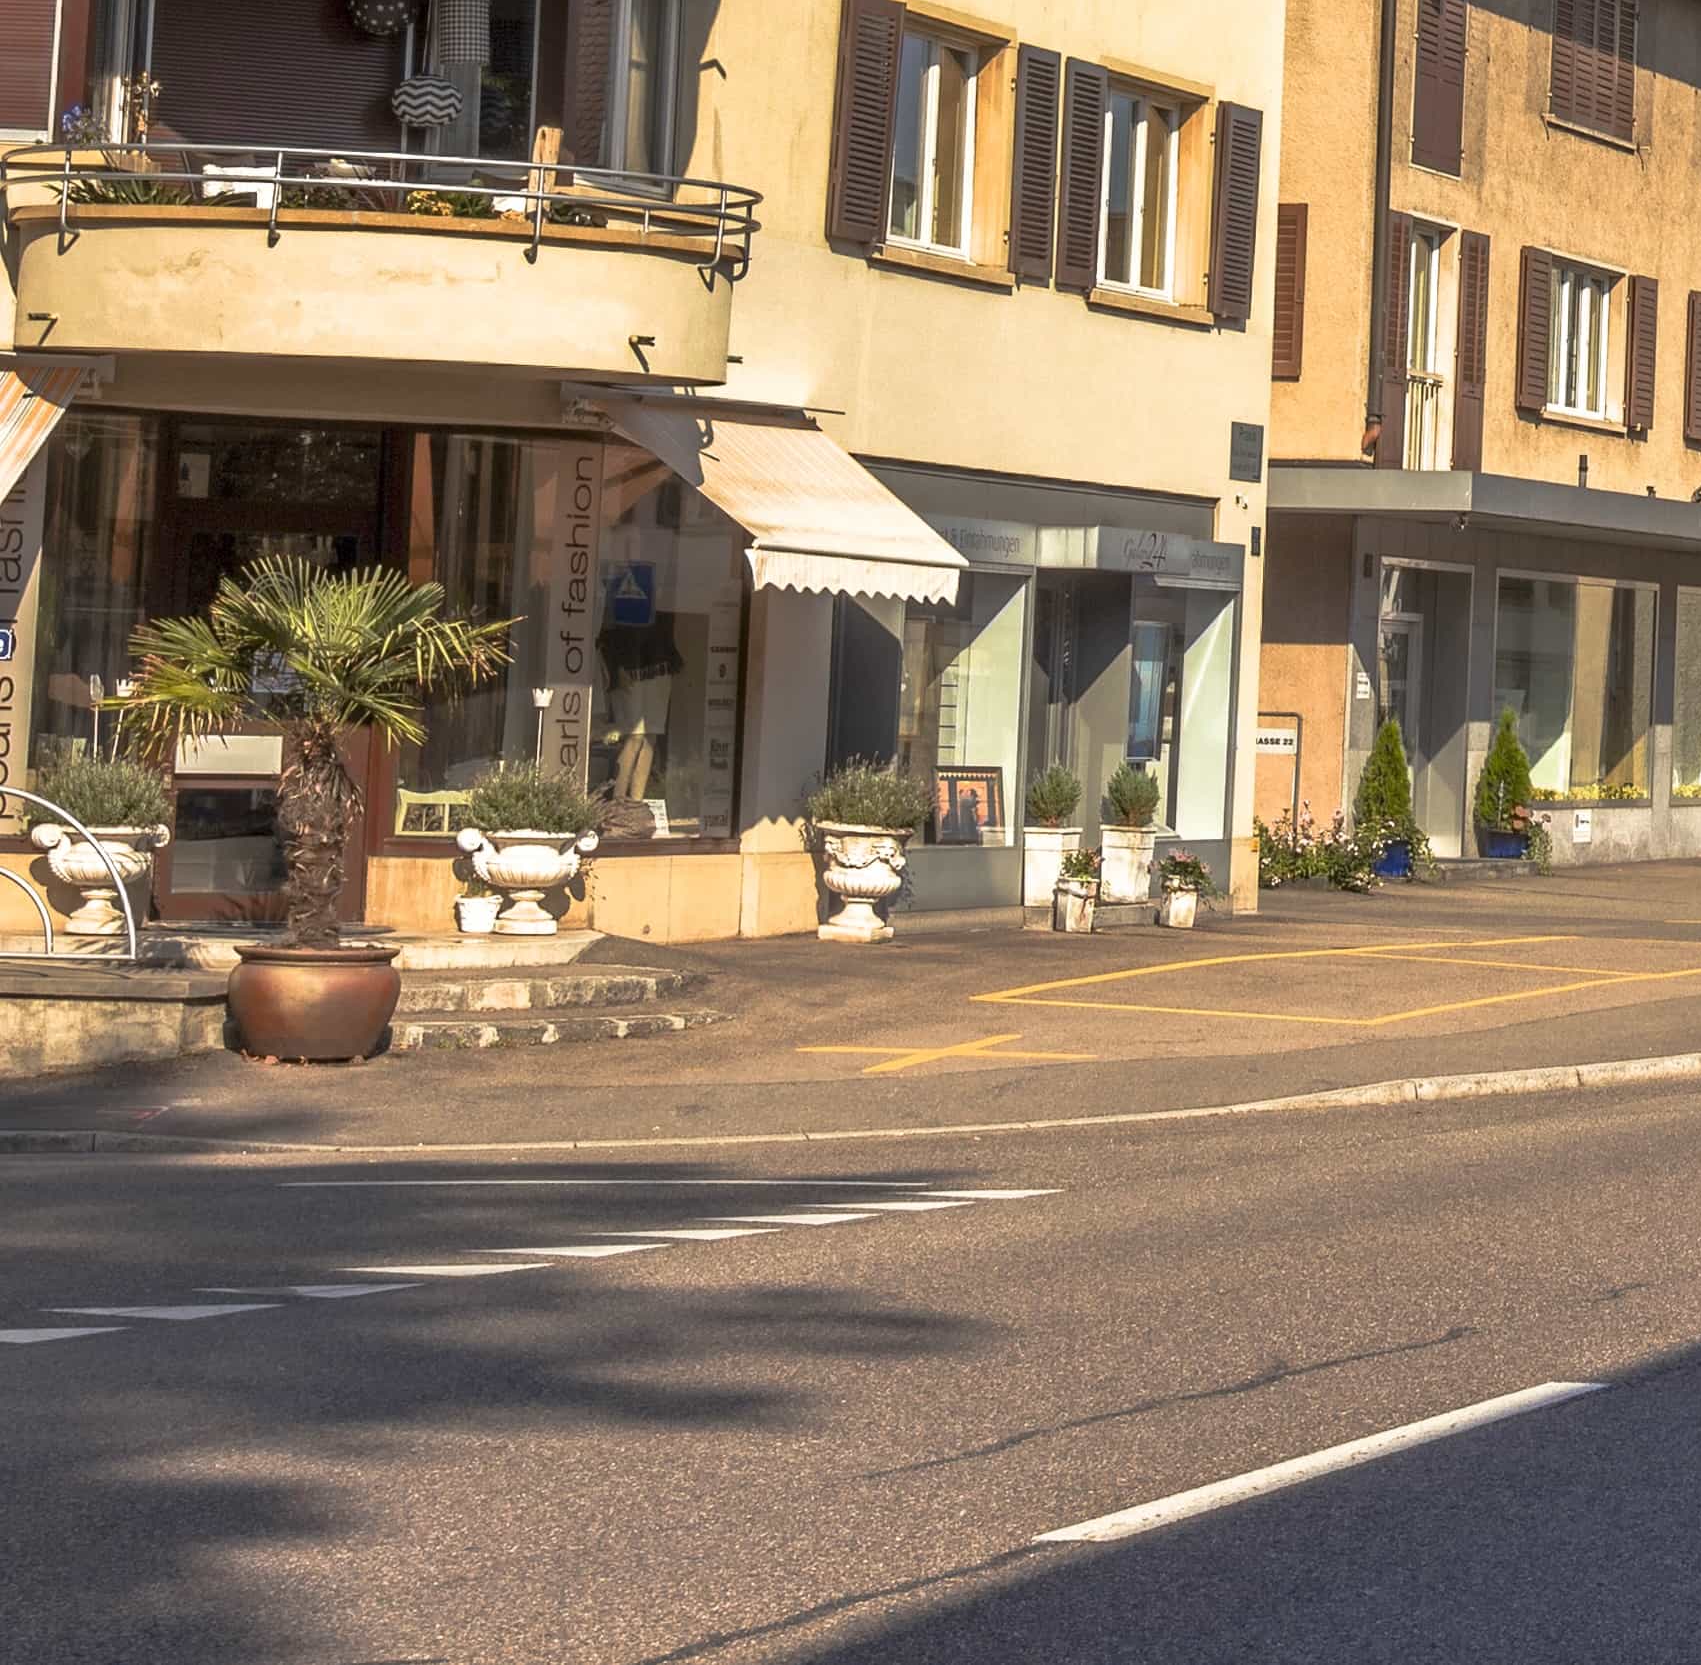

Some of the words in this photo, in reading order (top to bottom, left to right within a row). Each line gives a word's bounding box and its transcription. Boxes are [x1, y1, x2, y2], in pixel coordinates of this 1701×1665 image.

[561, 455, 593, 618] fashion
[560, 630, 585, 674] of
[555, 690, 581, 767] arls
[1256, 737, 1280, 745] ASSE
